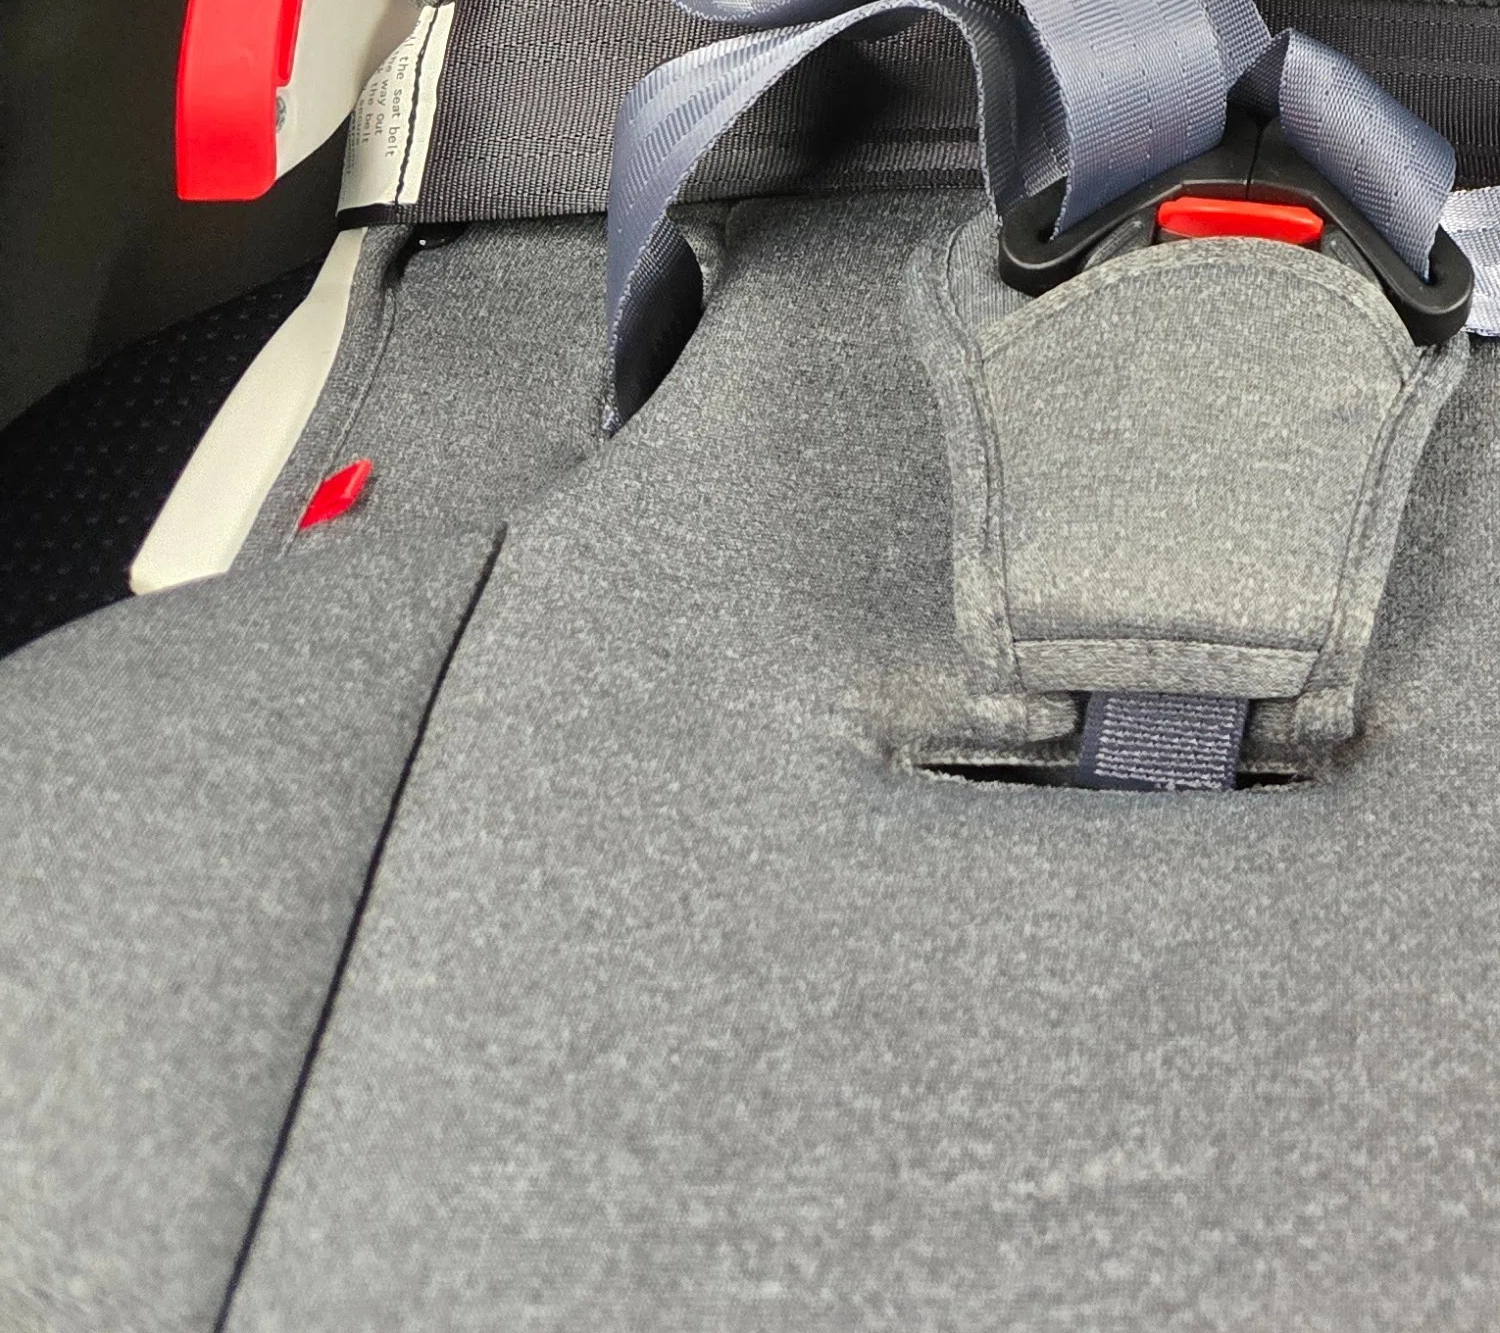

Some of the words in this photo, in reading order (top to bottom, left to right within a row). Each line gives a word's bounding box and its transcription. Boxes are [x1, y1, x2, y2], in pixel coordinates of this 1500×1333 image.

[397, 56, 409, 80] the
[377, 79, 389, 107] way
[392, 88, 402, 119] seat
[374, 113, 385, 136] out
[384, 126, 400, 157] belt
